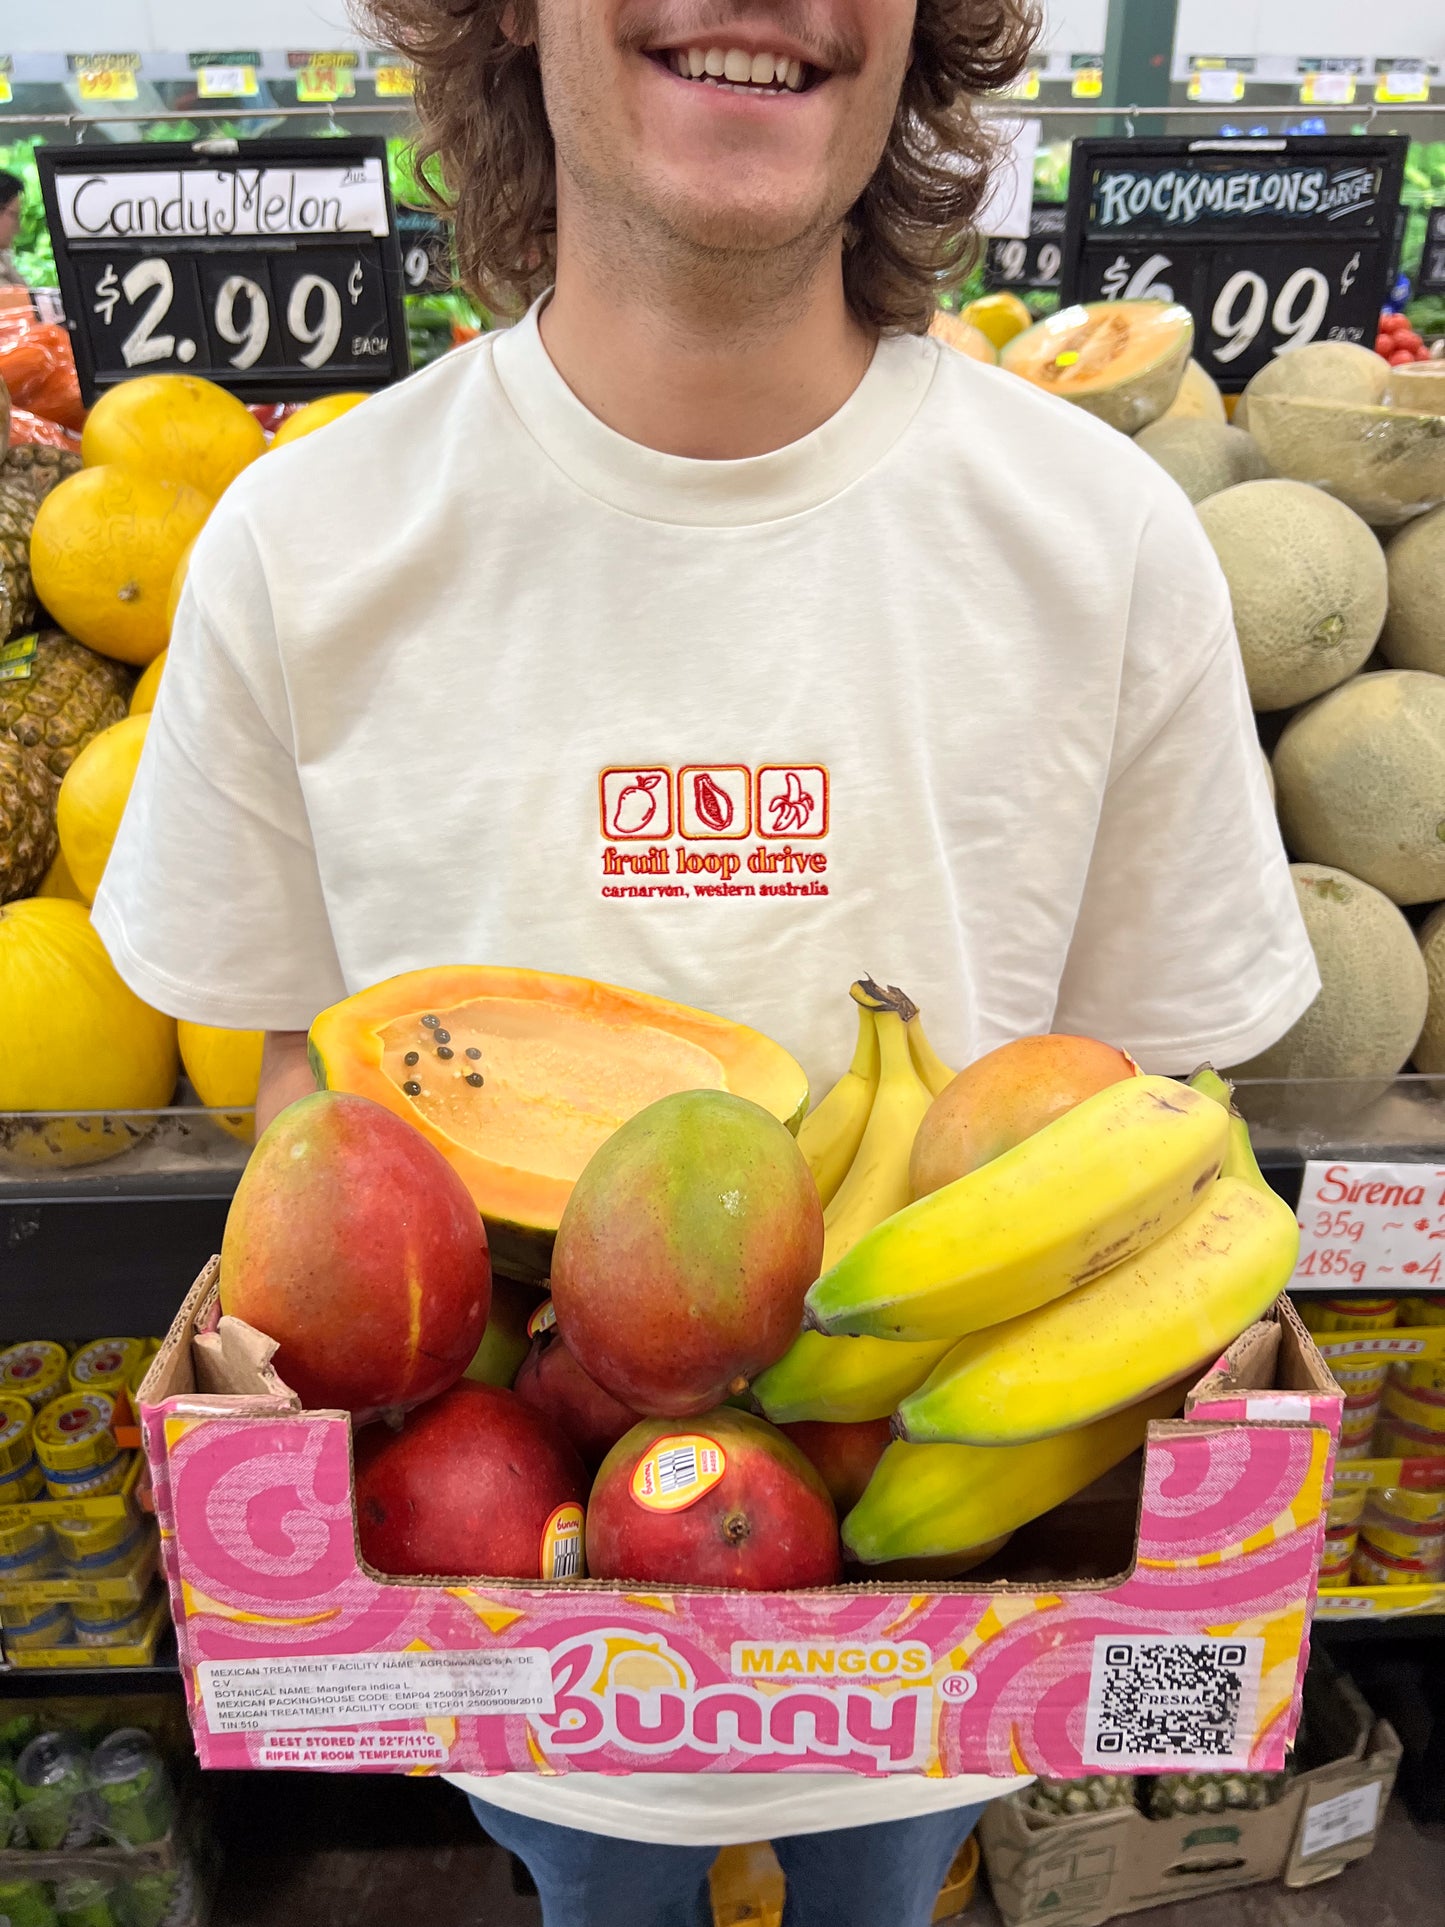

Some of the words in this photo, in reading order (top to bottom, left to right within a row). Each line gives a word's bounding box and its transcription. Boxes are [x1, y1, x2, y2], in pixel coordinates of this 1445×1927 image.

[73, 173, 208, 237] Candy
[214, 168, 343, 235] Melon
[1099, 171, 1324, 226] ROCKMELONS
[351, 336, 389, 356] EACH
[602, 846, 670, 875] fruit
[676, 845, 741, 880] loop
[747, 845, 828, 874] drive
[601, 884, 690, 899] carnarvon,
[694, 882, 756, 897] western
[759, 881, 829, 897] australia
[1316, 1165, 1426, 1207] Sirena
[1296, 1248, 1367, 1284] 185g
[211, 1667, 260, 1677] MEXICAN
[263, 1663, 328, 1675] TREATMENT
[331, 1661, 379, 1671] FACILITY
[518, 1656, 534, 1665] DE
[741, 1648, 927, 1674] MANGOS
[214, 1688, 276, 1698] BOTANICAL
[279, 1686, 312, 1695] NAME:
[316, 1684, 367, 1695] Mangifera
[370, 1681, 401, 1690] indica
[1139, 1692, 1202, 1705] FRESKA
[217, 1698, 266, 1709] MEXICAN
[269, 1694, 355, 1707] PACKINGHOUSE
[358, 1693, 392, 1702] CODE:
[395, 1691, 430, 1700] EMP04
[218, 1710, 268, 1719] MEXICAN
[271, 1707, 335, 1717] TREATMENT
[338, 1703, 385, 1713] FACILITY
[270, 1736, 300, 1747] BEST
[306, 1736, 355, 1747] STORED
[360, 1736, 374, 1746] AT
[265, 1750, 300, 1761] RIPEN
[303, 1750, 318, 1760] AT
[321, 1750, 354, 1760] ROOM
[359, 1749, 443, 1760] TEMPERATURE
